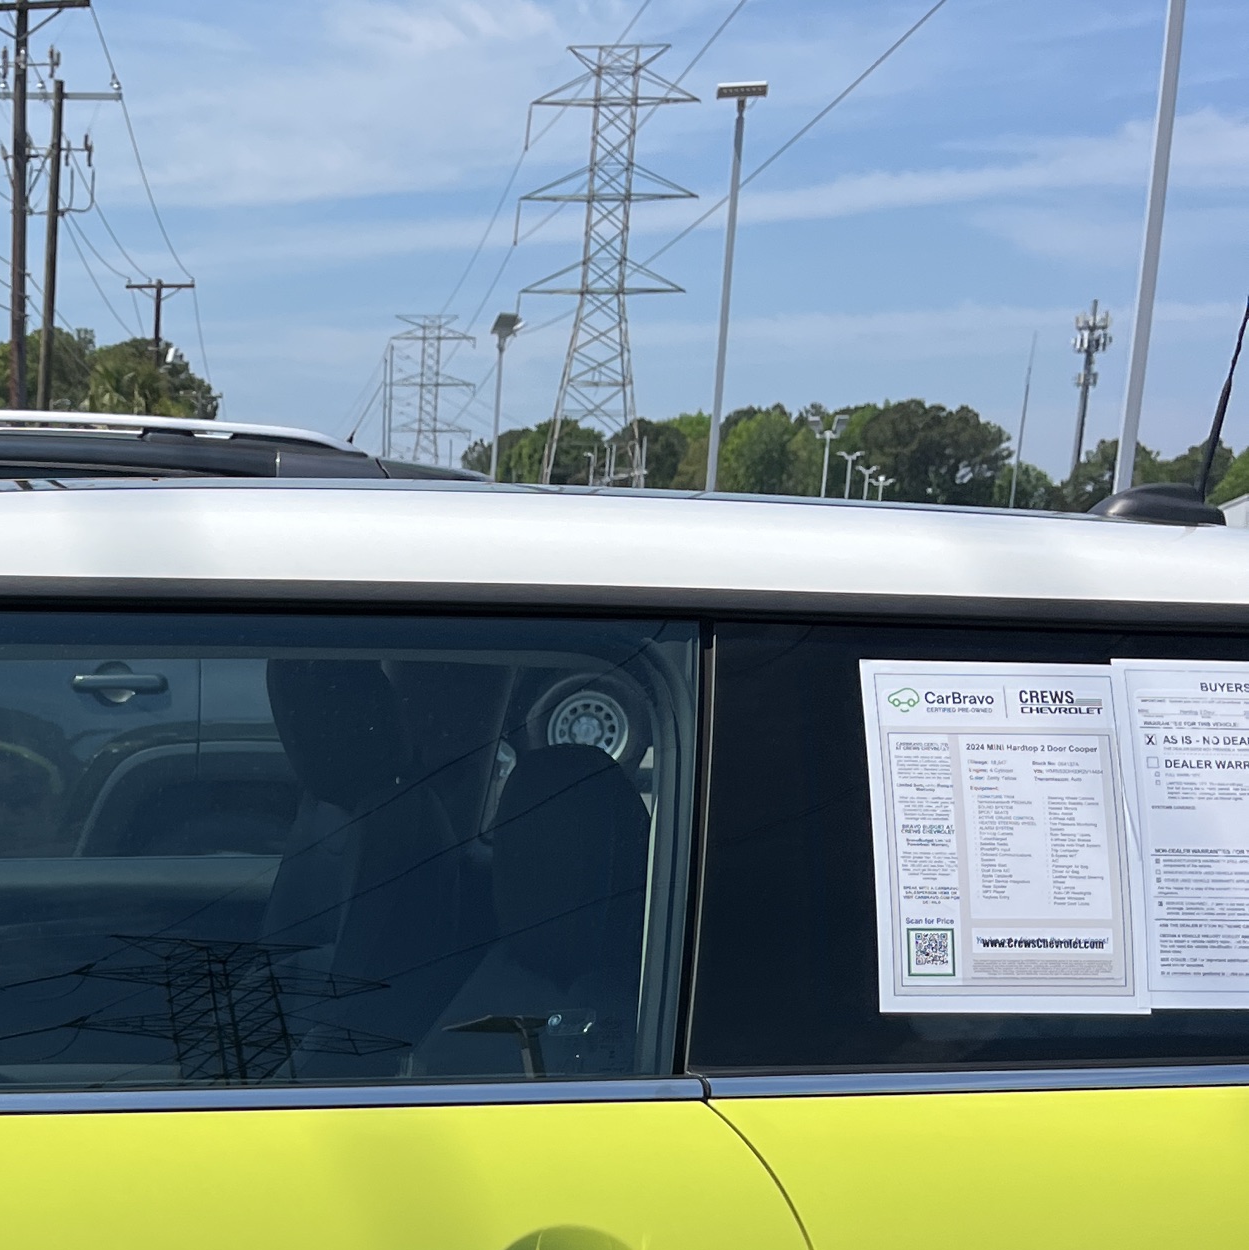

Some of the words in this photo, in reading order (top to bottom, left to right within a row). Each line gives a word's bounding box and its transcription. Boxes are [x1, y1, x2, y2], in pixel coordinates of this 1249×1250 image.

[1200, 683, 1249, 693] BUYERS
[924, 691, 994, 705] CarBravo
[1019, 689, 1075, 704] CREWS
[1020, 706, 1103, 715] CHEVROLET
[1163, 736, 1178, 745] AS
[1182, 736, 1192, 745] IS
[1203, 736, 1220, 745] NO
[1223, 736, 1249, 745] DEA
[966, 743, 985, 751] 2024
[986, 743, 1004, 751] MINI
[1006, 744, 1038, 754] Hardtop
[1040, 744, 1045, 752] 2
[1047, 744, 1067, 752] Door
[1068, 745, 1098, 754] Cooper
[1165, 759, 1212, 769] DEALER
[981, 937, 1104, 949] www.CrewsChevrolet.com
